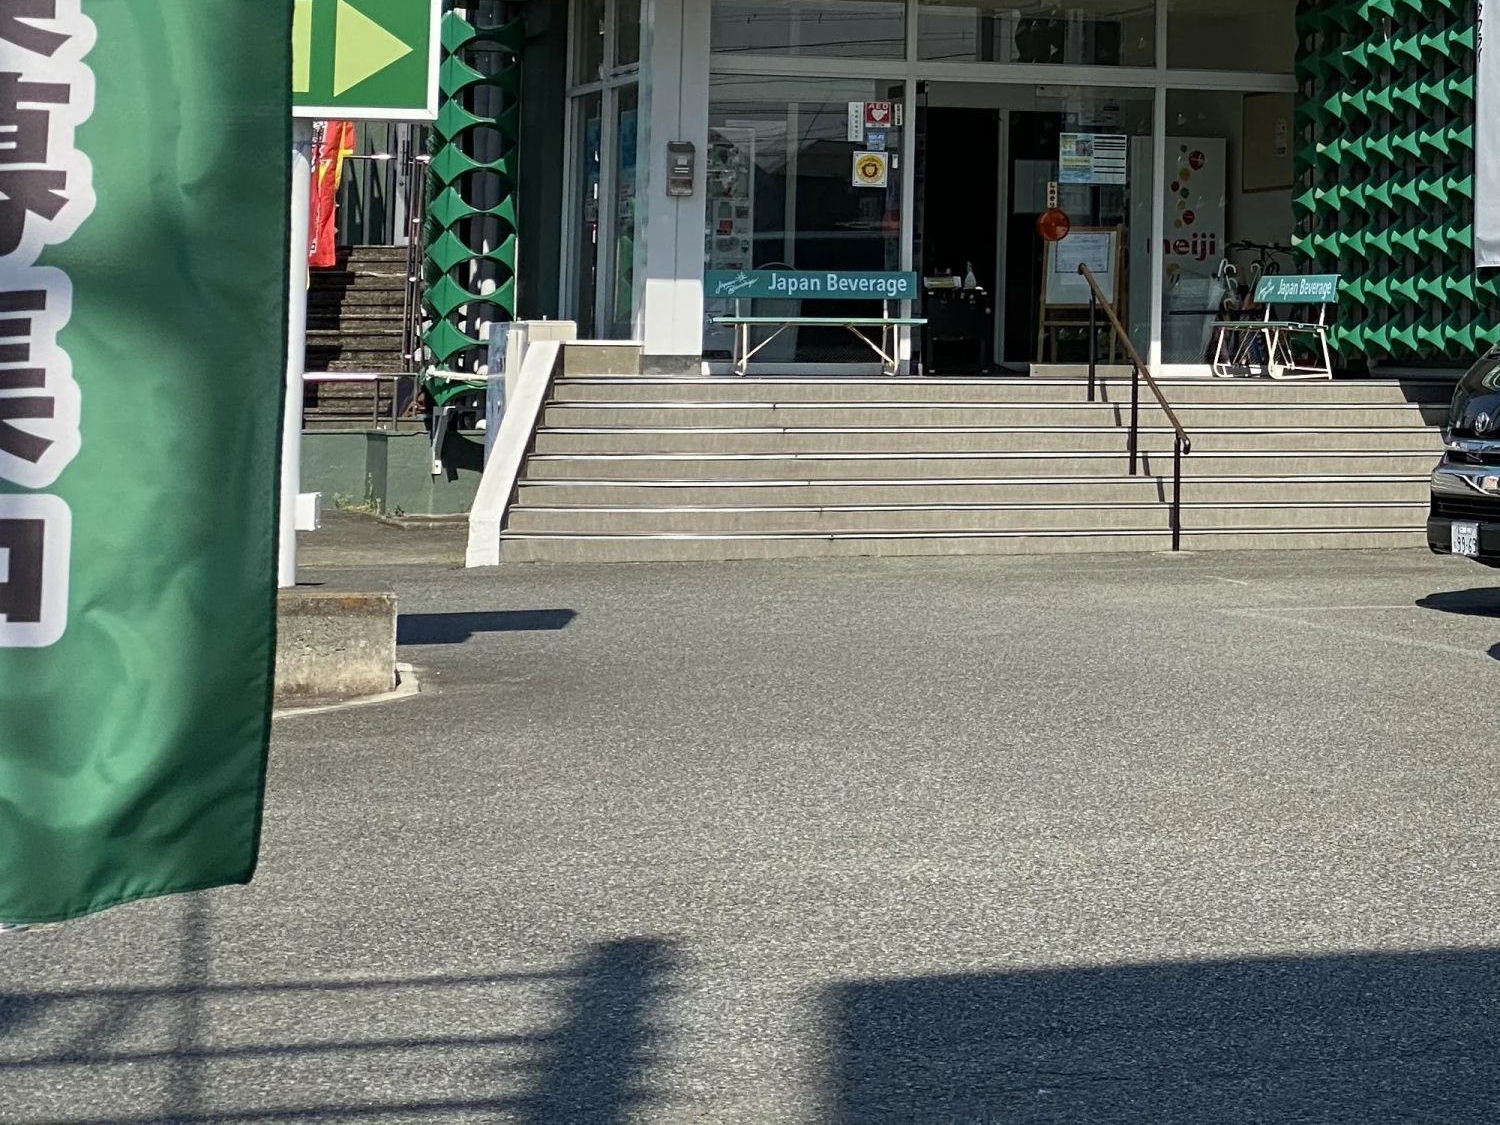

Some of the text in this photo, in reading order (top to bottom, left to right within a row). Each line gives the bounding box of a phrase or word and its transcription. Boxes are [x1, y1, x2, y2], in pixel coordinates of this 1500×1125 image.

[767, 273, 907, 296] Japan Beverage
[1277, 279, 1299, 300] Japan
[1299, 279, 1332, 300] Beverage
